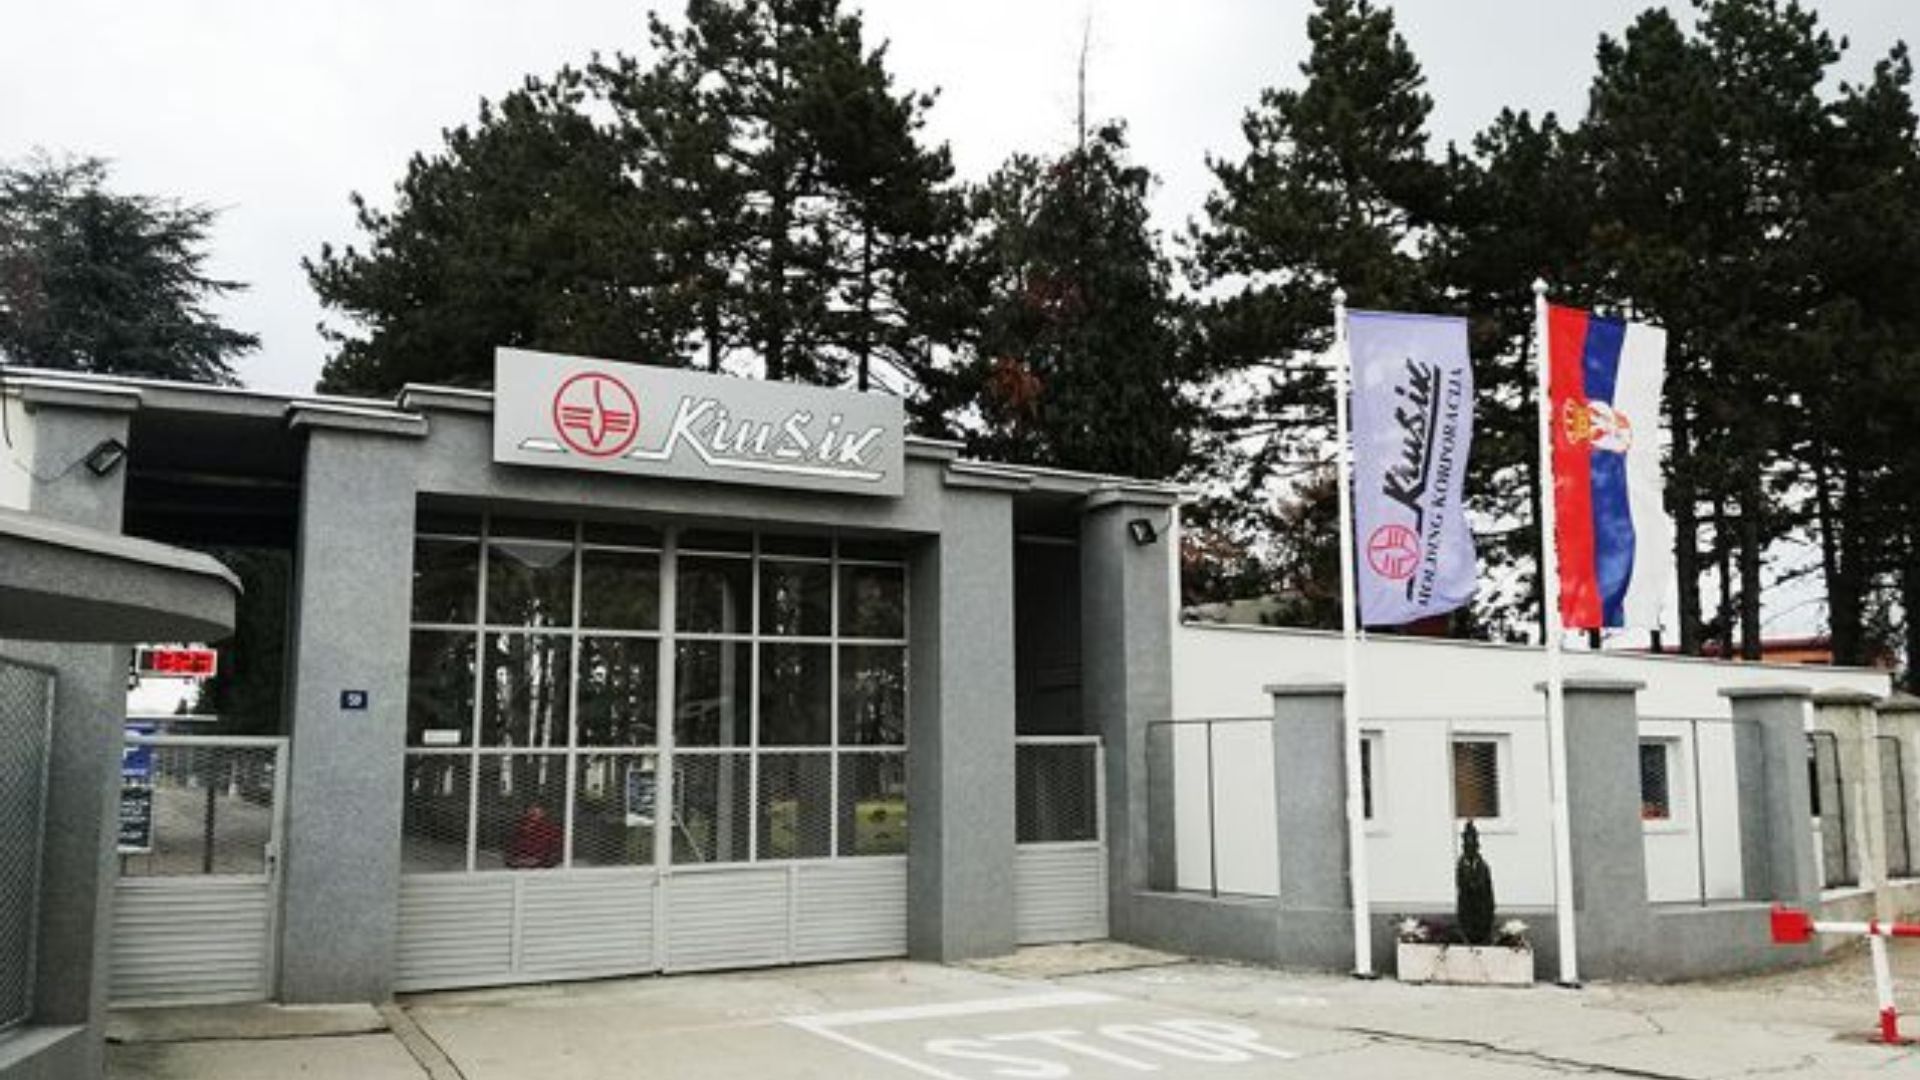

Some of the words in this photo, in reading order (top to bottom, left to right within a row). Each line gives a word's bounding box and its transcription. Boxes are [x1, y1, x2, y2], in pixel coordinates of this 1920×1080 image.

[1417, 514, 1443, 607] HOLDING
[1432, 368, 1463, 508] KORPORACIJA
[925, 1018, 1301, 1079] STOP
